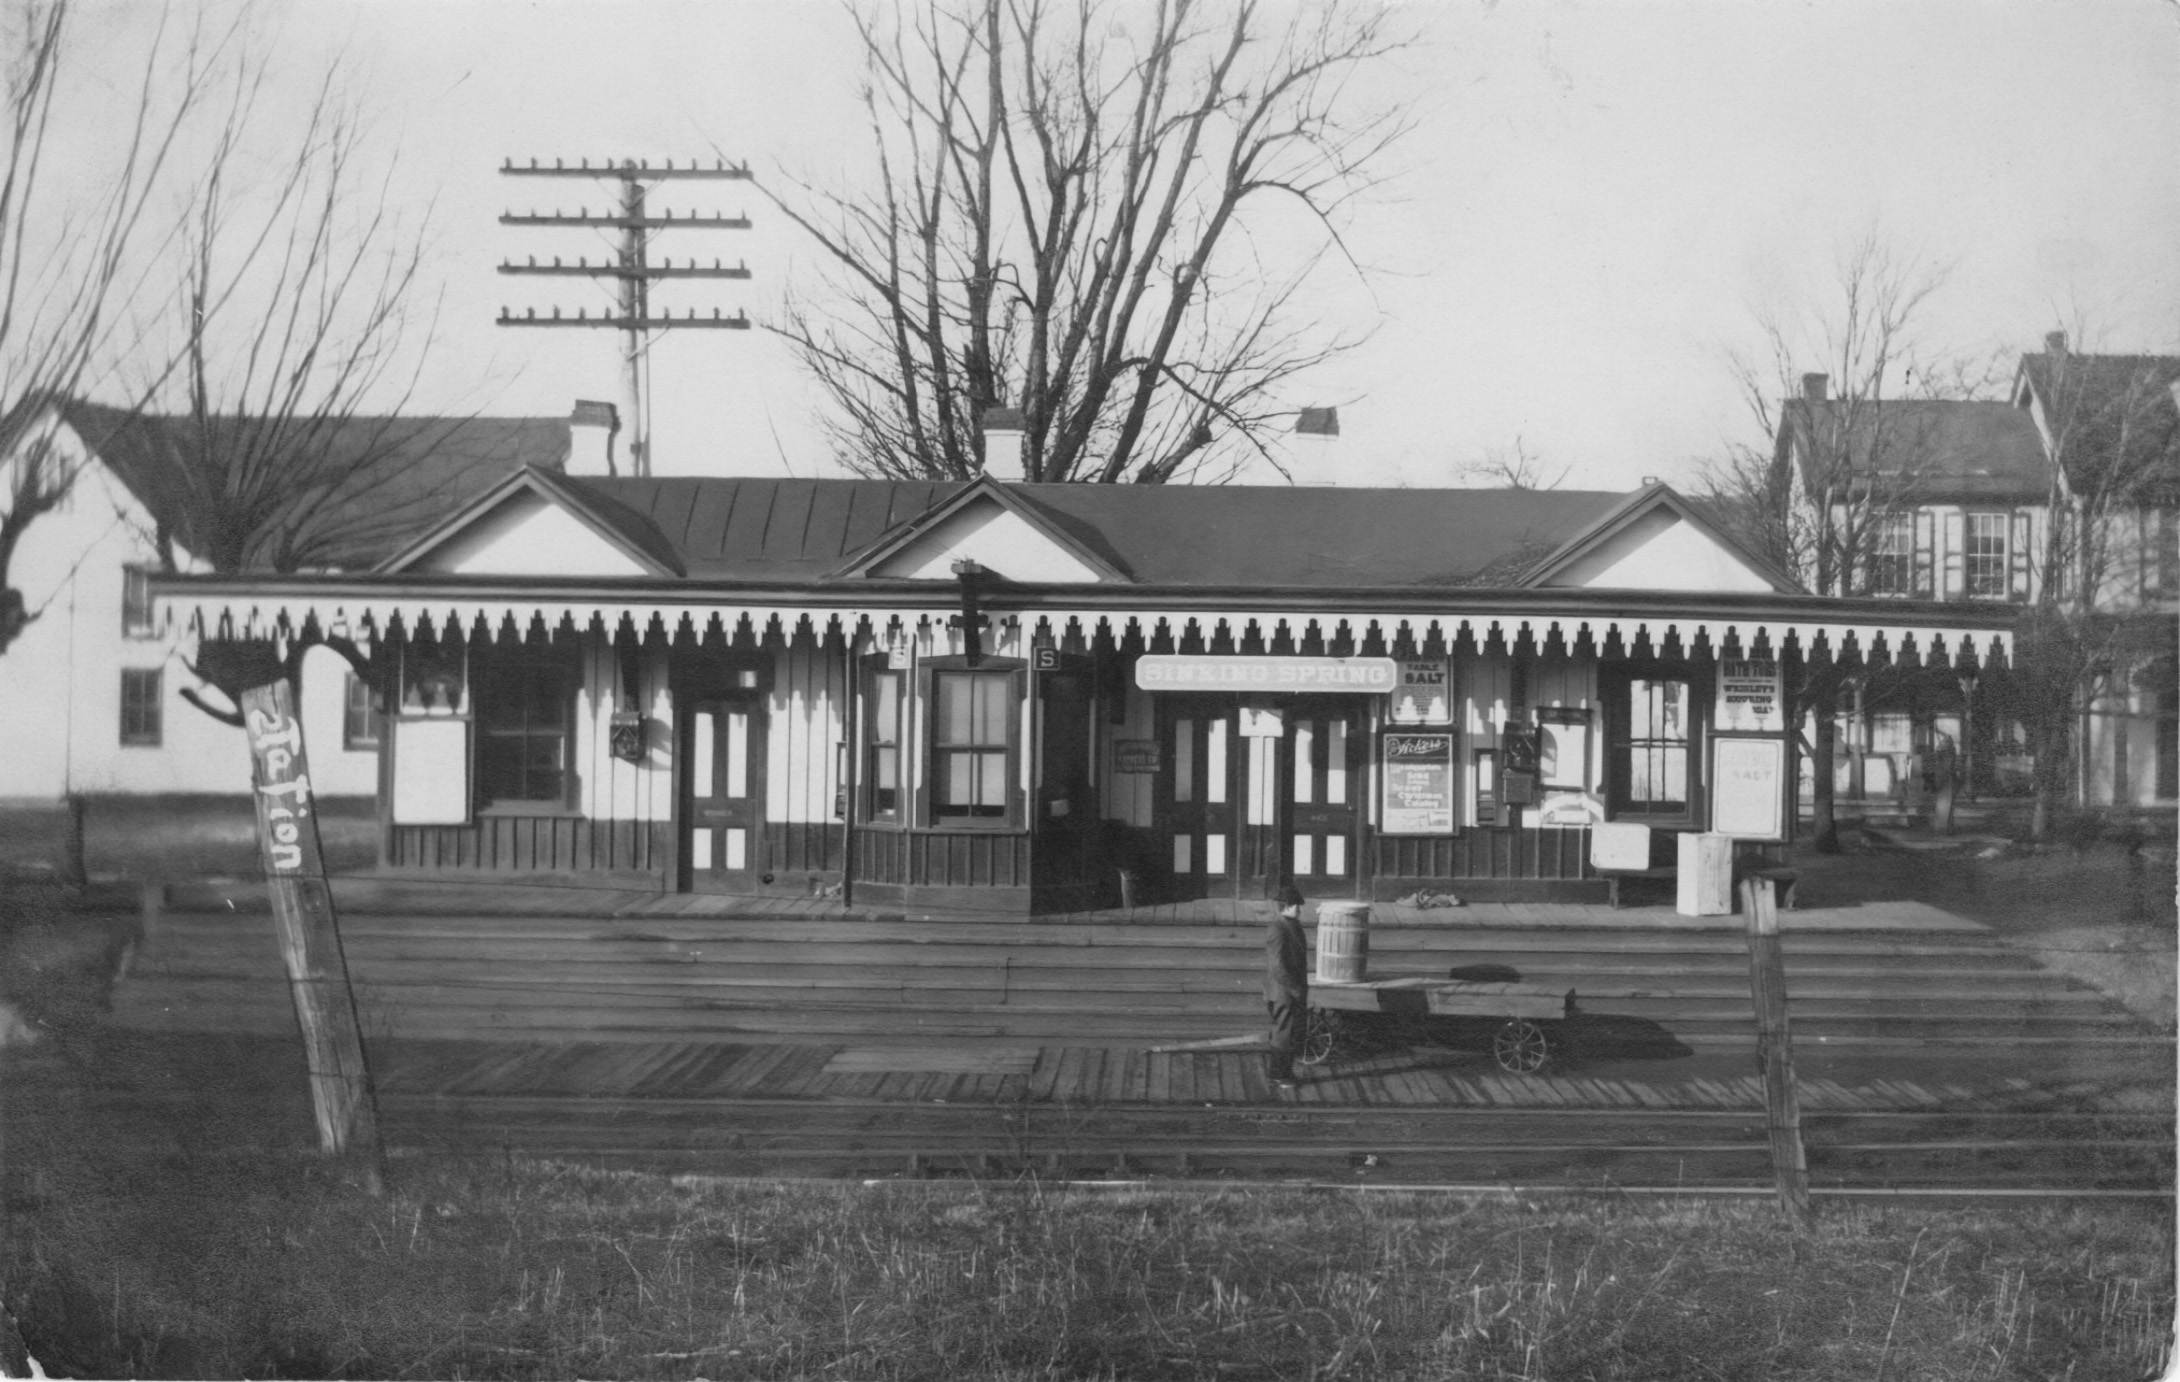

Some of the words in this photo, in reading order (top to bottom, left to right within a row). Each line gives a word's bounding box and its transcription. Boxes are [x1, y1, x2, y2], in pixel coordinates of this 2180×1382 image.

[893, 648, 907, 666] S
[1040, 650, 1055, 667] S
[1145, 662, 1268, 682] SINKING
[1278, 665, 1388, 685] SPRING
[1404, 672, 1445, 684] SALT
